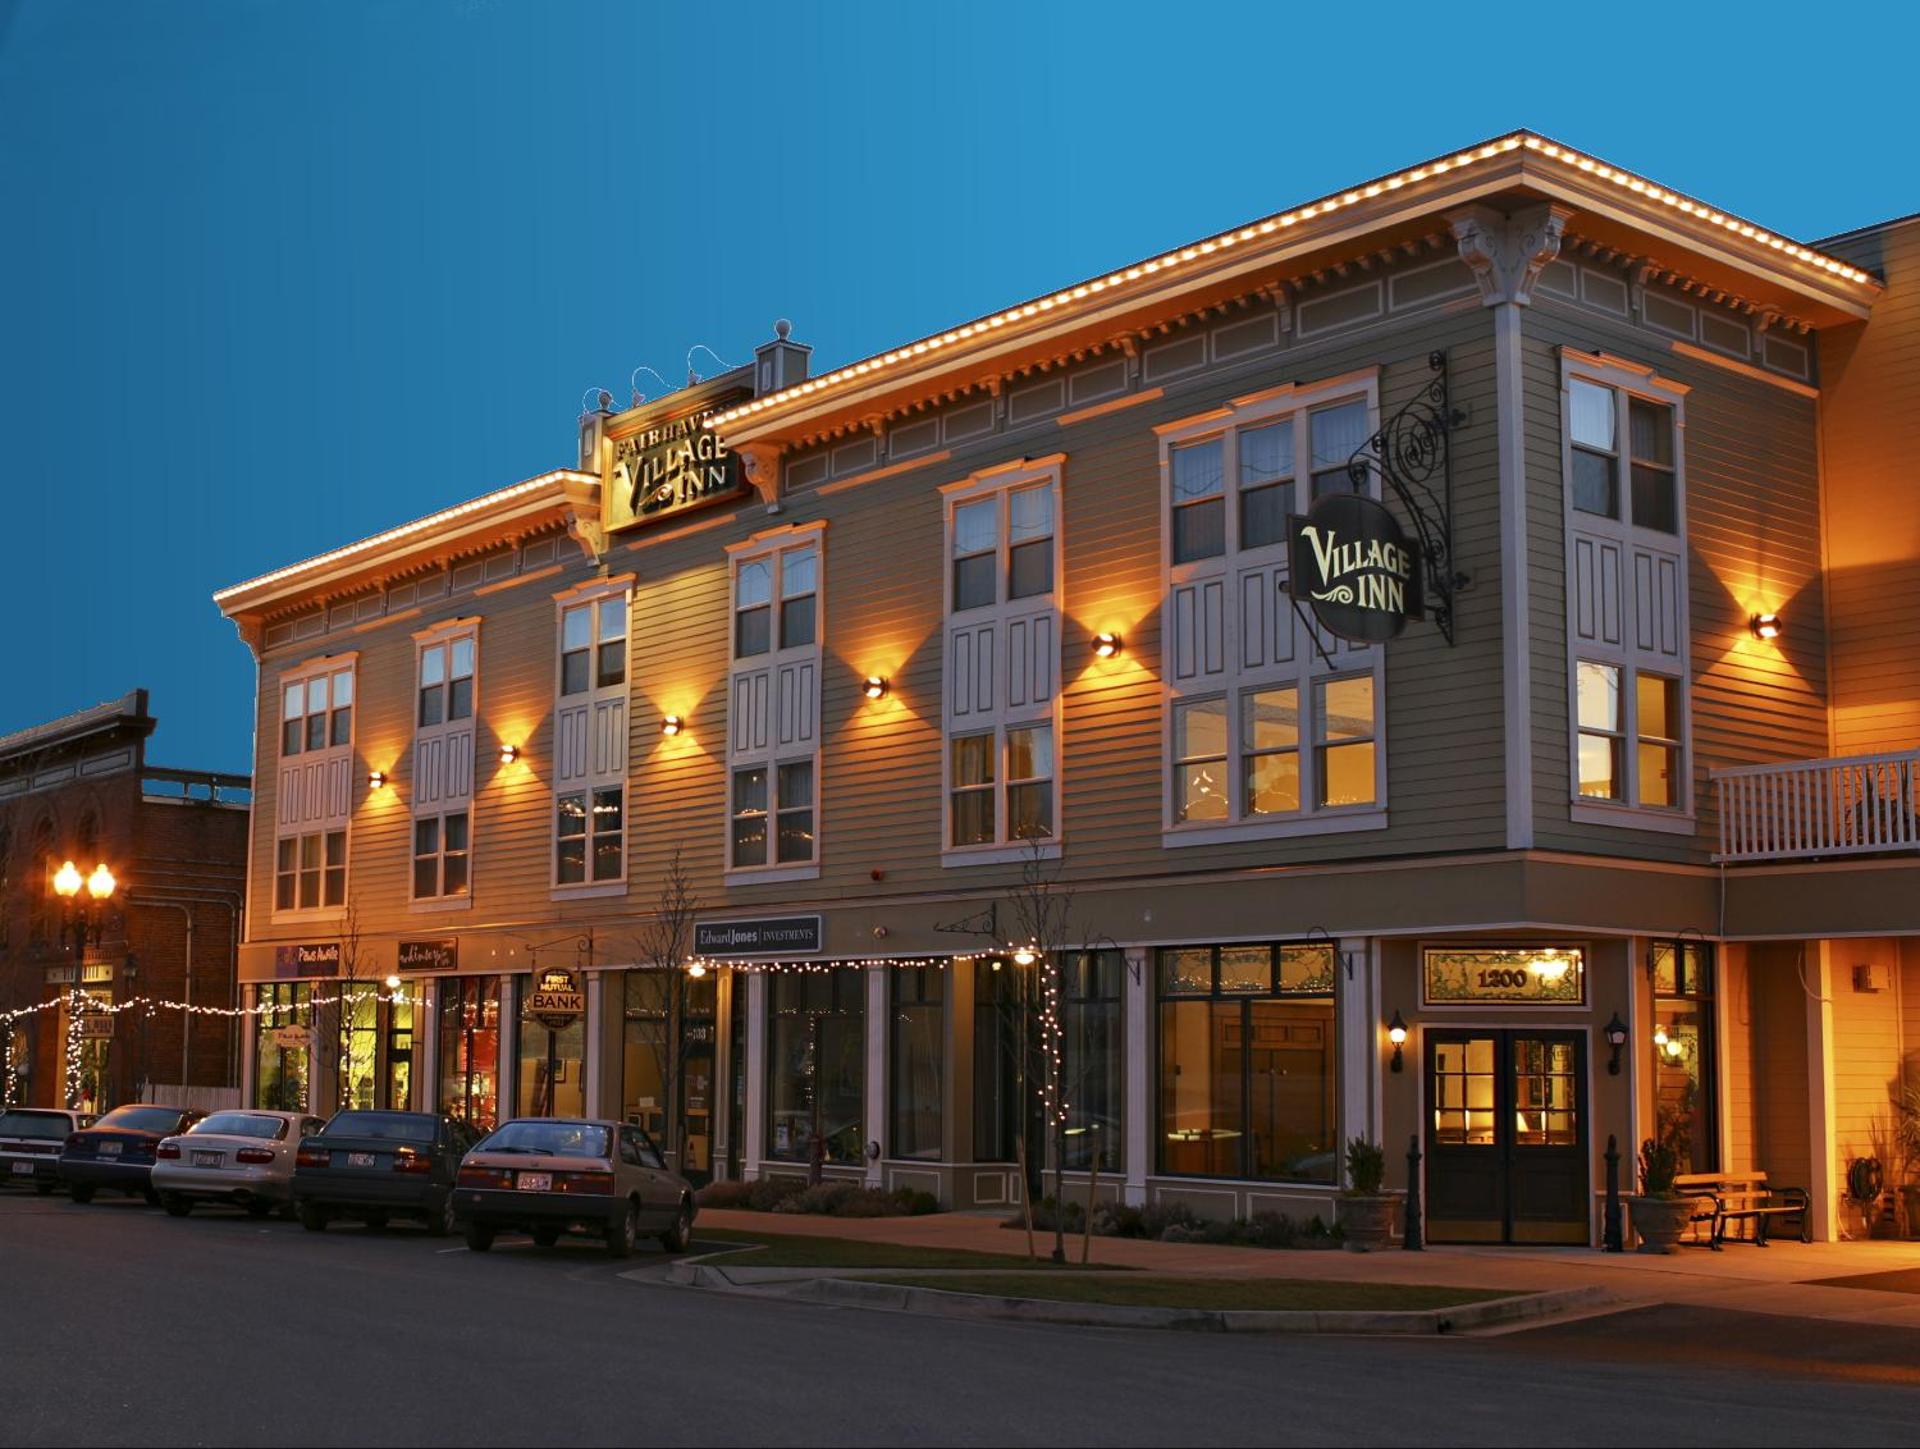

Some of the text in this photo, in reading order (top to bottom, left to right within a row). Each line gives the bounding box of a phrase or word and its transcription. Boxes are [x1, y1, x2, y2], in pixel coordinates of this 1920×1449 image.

[613, 434, 728, 516] VILLAGE
[674, 466, 726, 505] INN
[1300, 525, 1411, 588] VILLAGE
[1357, 573, 1404, 614] INN
[763, 928, 814, 941] INVESTMENTS
[540, 983, 574, 992] MUTUAL
[545, 974, 569, 984] FIRST
[1477, 968, 1527, 988] 1200
[533, 994, 581, 1009] BANK
